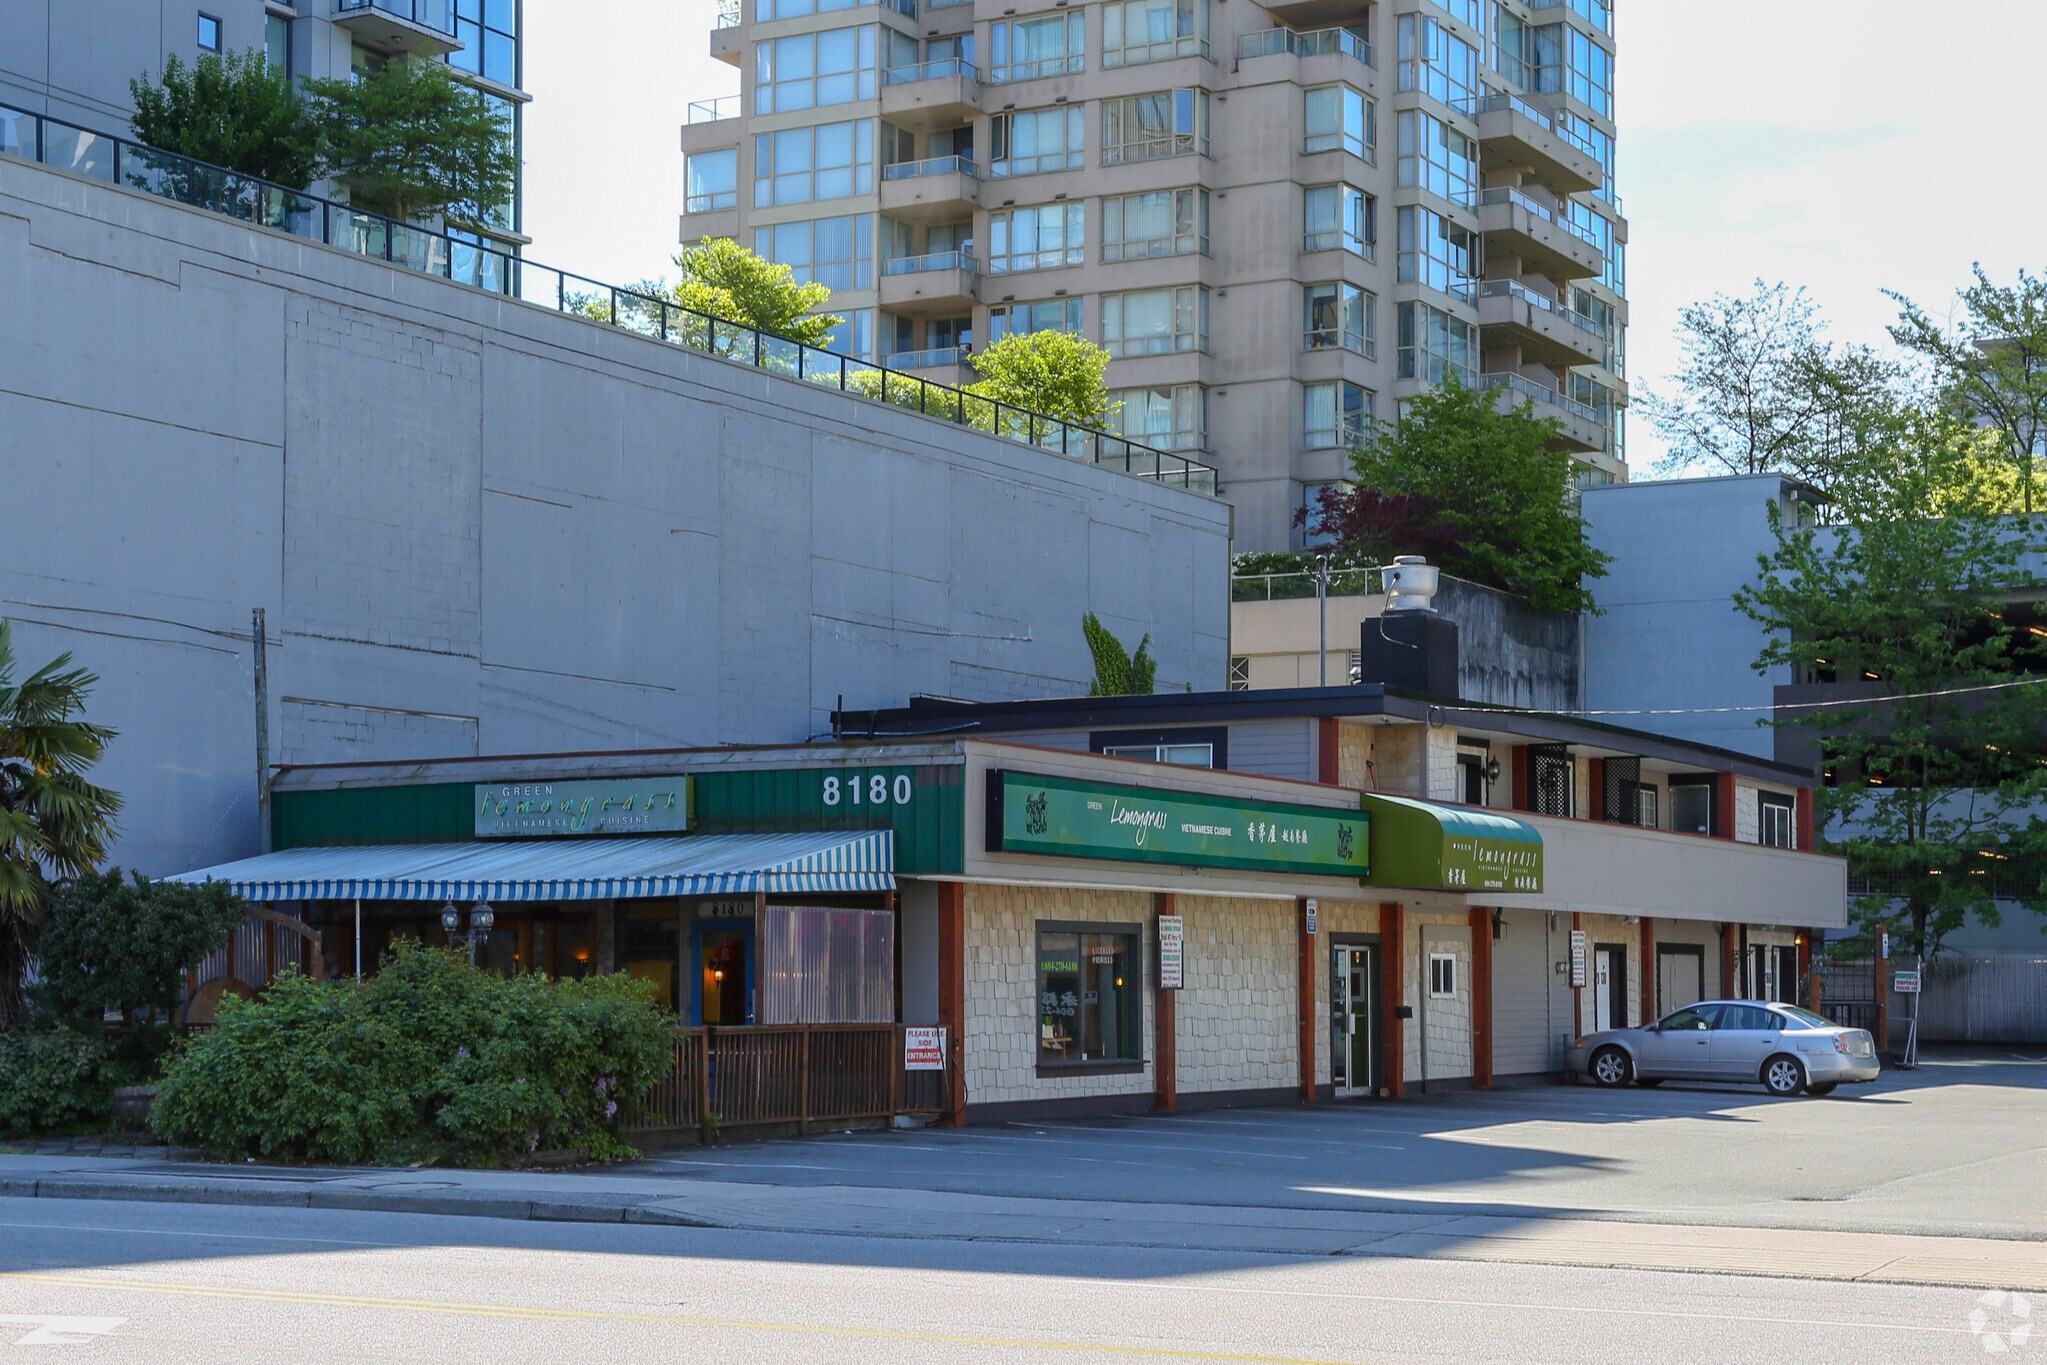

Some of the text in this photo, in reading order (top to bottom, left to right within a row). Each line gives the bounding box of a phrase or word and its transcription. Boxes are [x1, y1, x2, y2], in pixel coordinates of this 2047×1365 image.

[502, 786, 553, 797] GREEN
[823, 774, 911, 806] 8180
[481, 791, 677, 832] lemongrass
[1087, 801, 1103, 811] GREEN
[494, 816, 650, 829] VIETNAMESE CUISINE
[1110, 798, 1168, 846] Lemongrass
[1181, 823, 1232, 837] VIETNAMESE CUISINE
[1473, 839, 1537, 880] lemongrass
[712, 902, 744, 917] 8180
